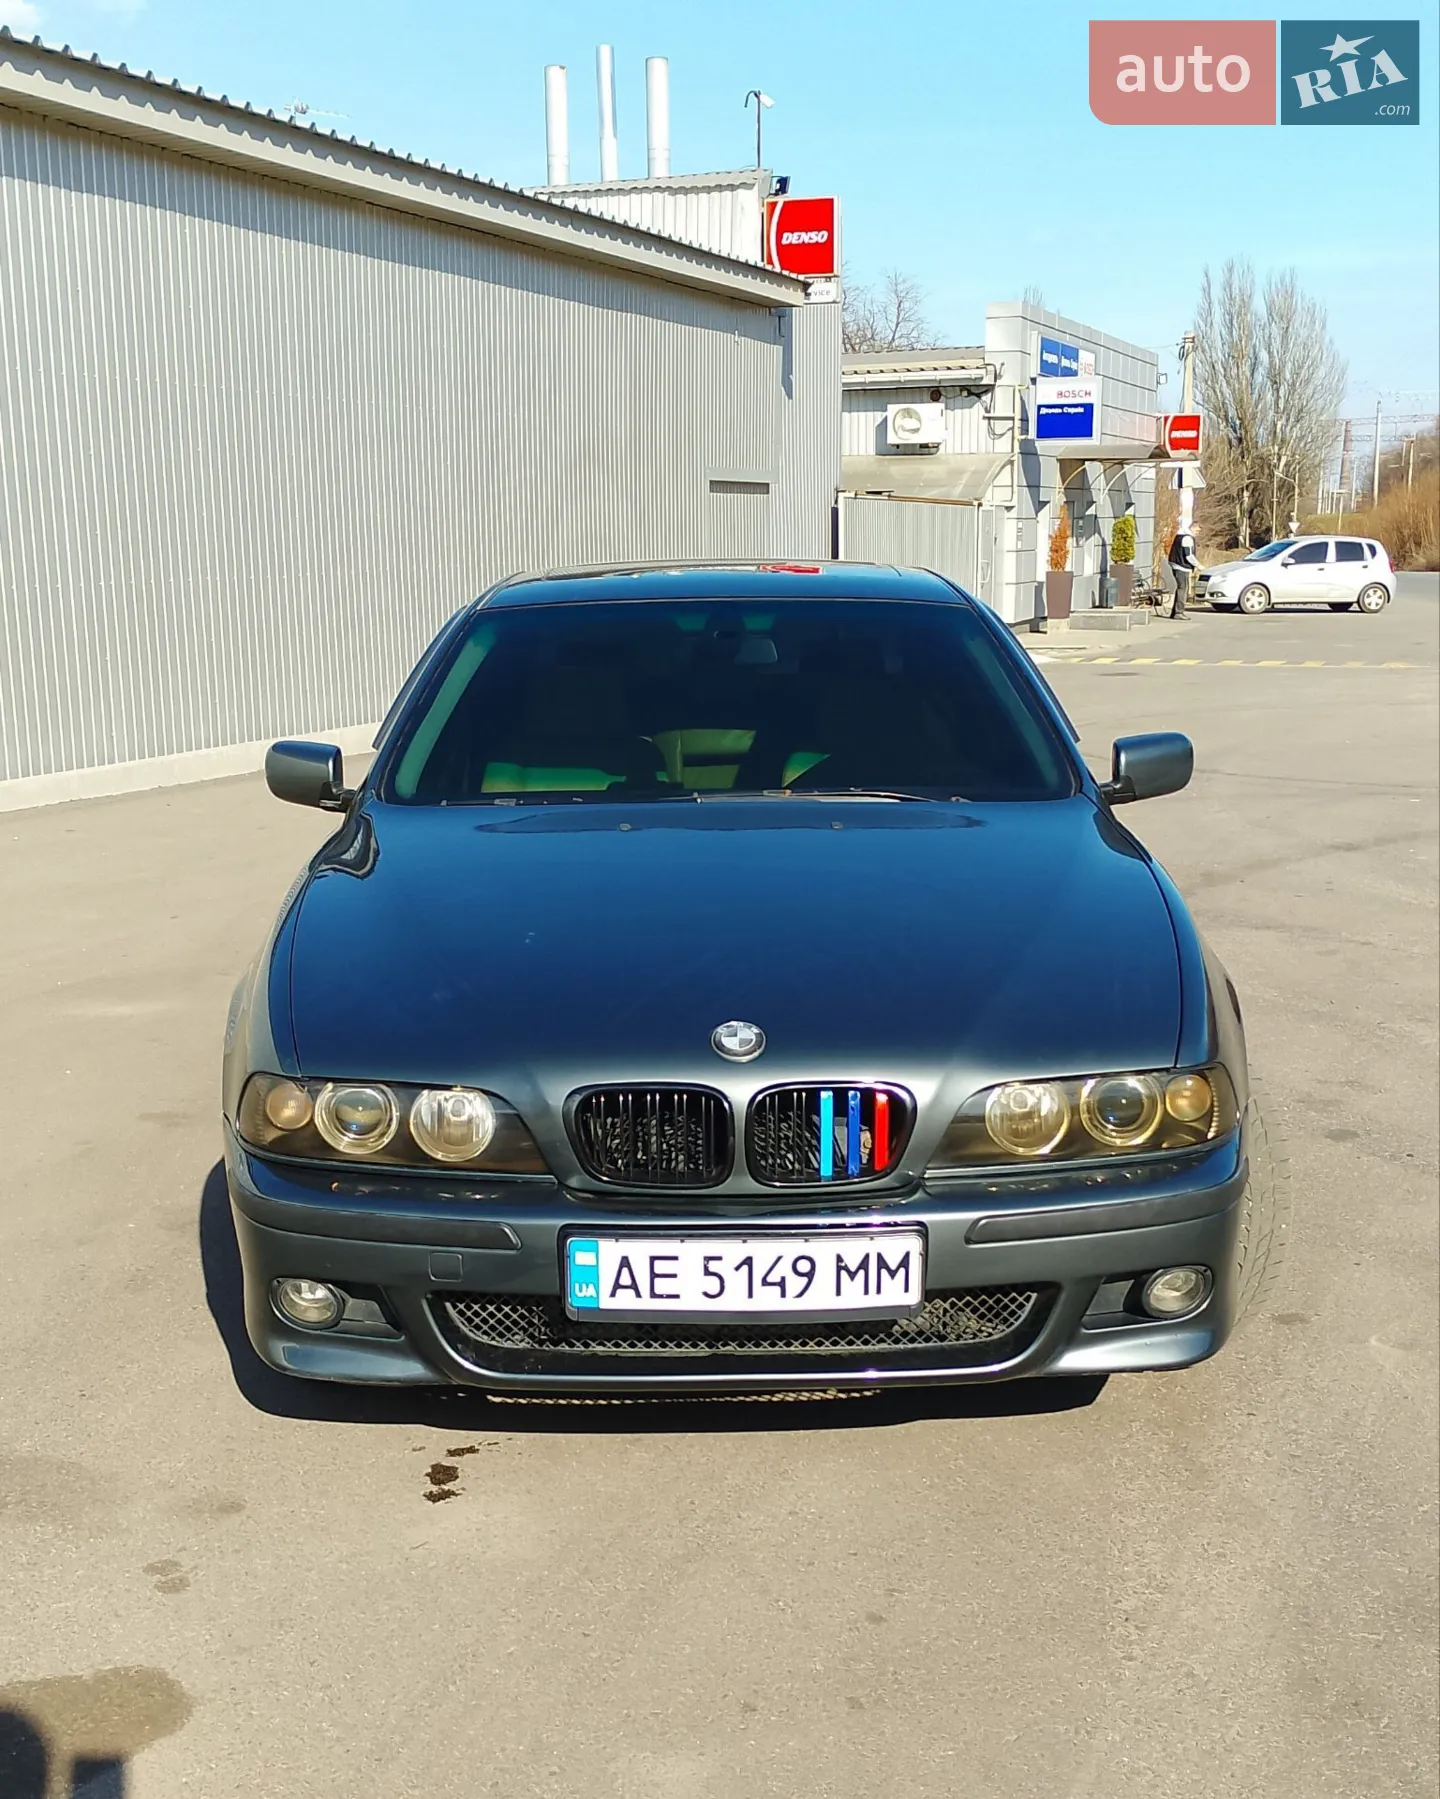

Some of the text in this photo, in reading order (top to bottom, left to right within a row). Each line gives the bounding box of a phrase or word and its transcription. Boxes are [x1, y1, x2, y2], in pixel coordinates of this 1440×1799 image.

[781, 230, 829, 245] DENSO
[1056, 389, 1092, 399] BOSCH
[609, 1250, 911, 1299] AE 5149 MM
[574, 1283, 598, 1299] UA
